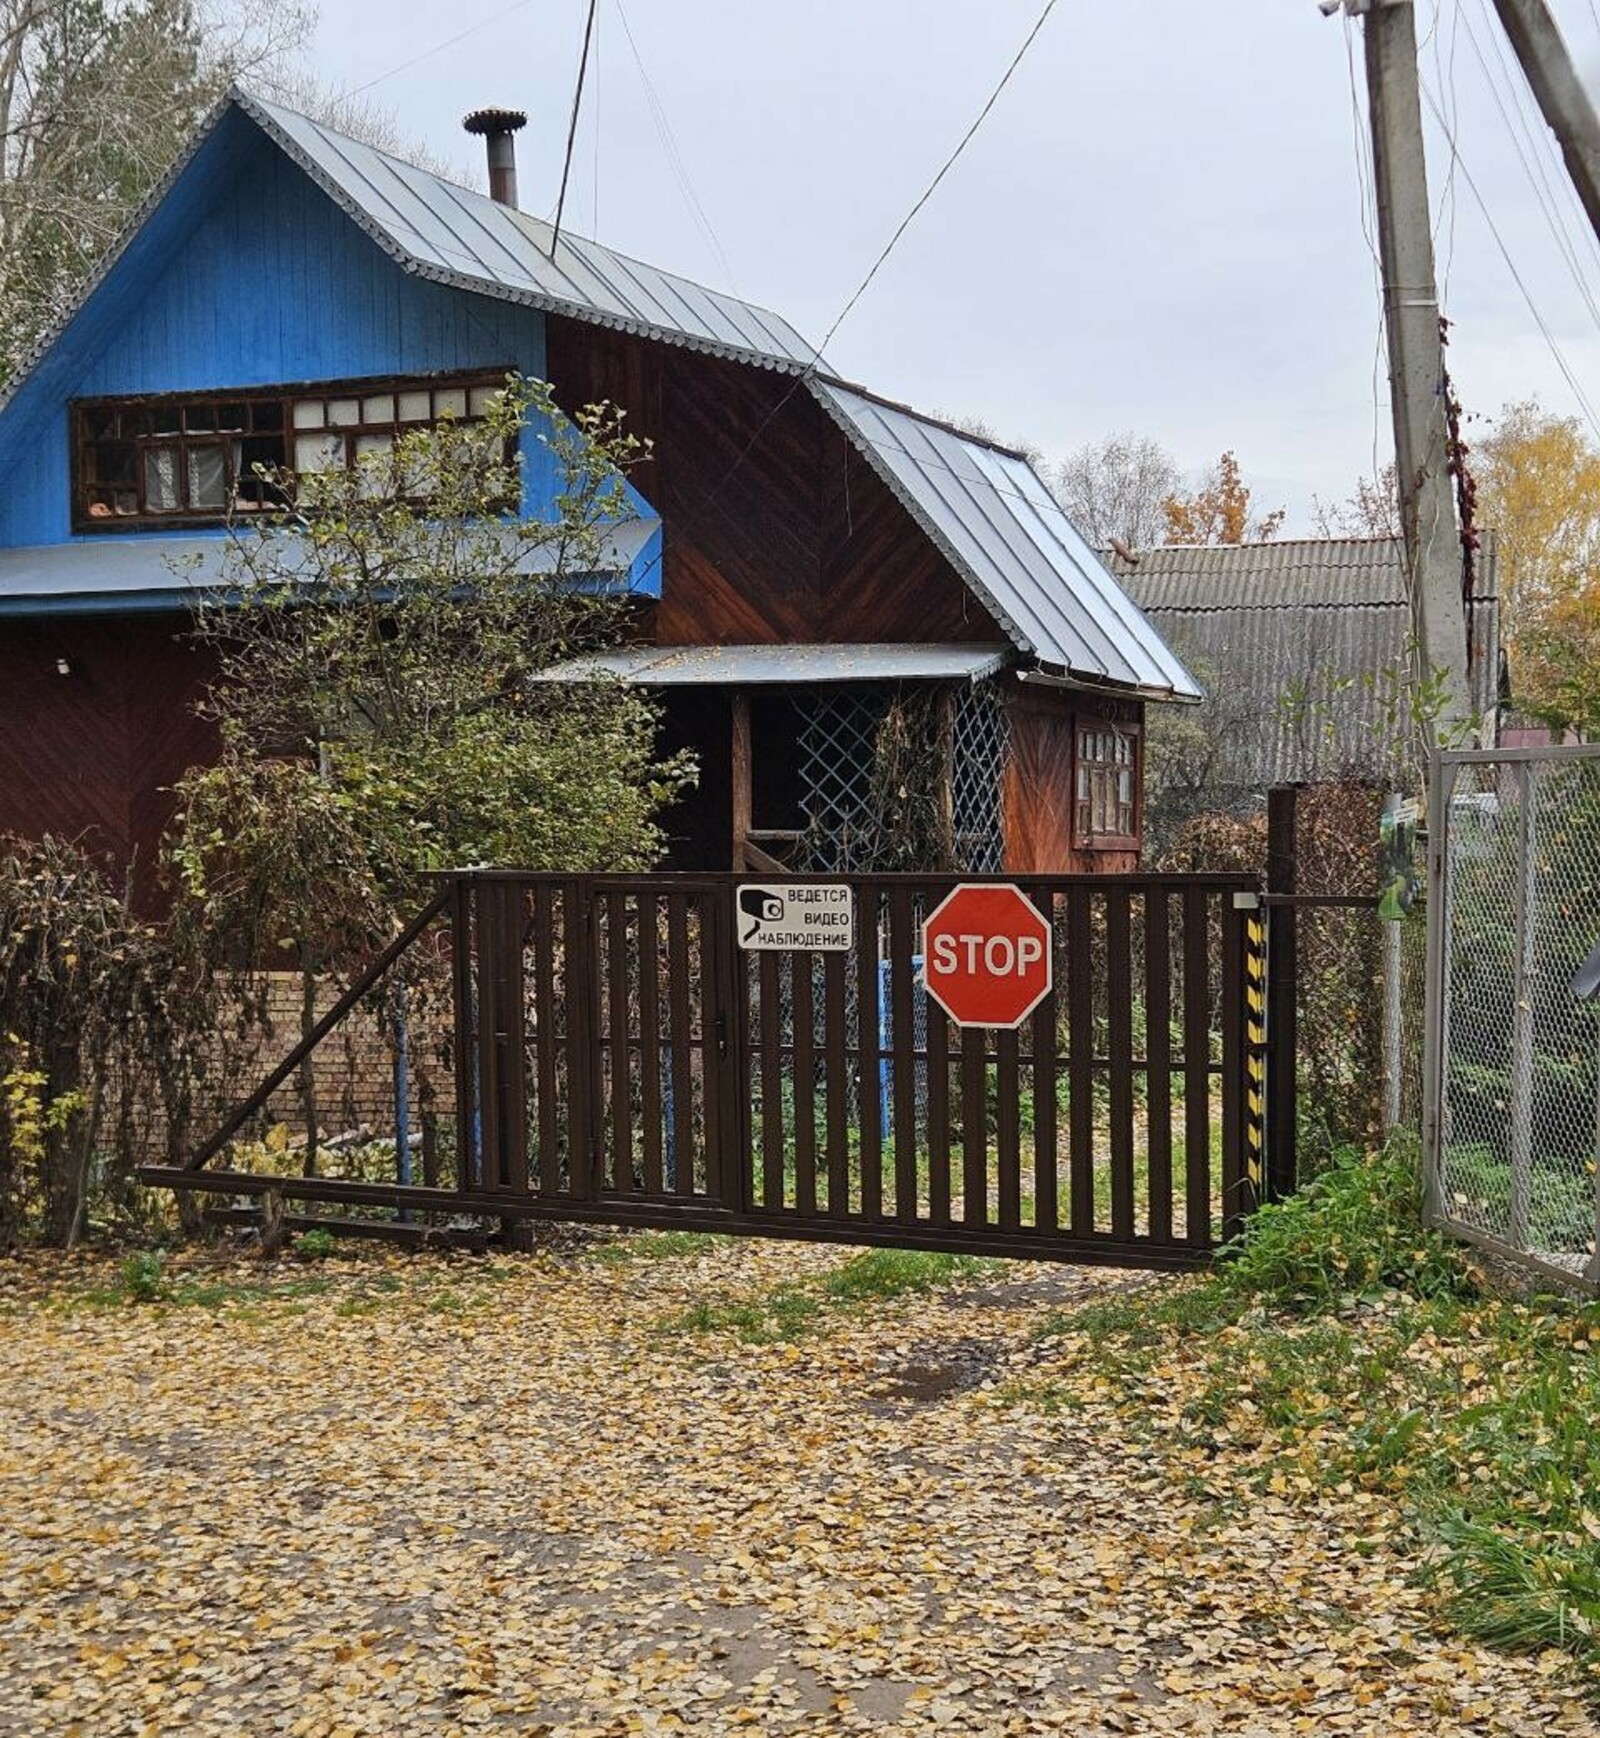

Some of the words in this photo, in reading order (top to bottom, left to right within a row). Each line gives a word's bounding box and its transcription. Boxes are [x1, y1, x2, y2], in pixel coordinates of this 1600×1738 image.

[788, 889, 847, 904] ВЕДЕТСЯ
[804, 912, 849, 927] ВИДЕО
[758, 932, 849, 947] НАБЛЮДЕНИЕ
[933, 934, 1042, 977] STOP
